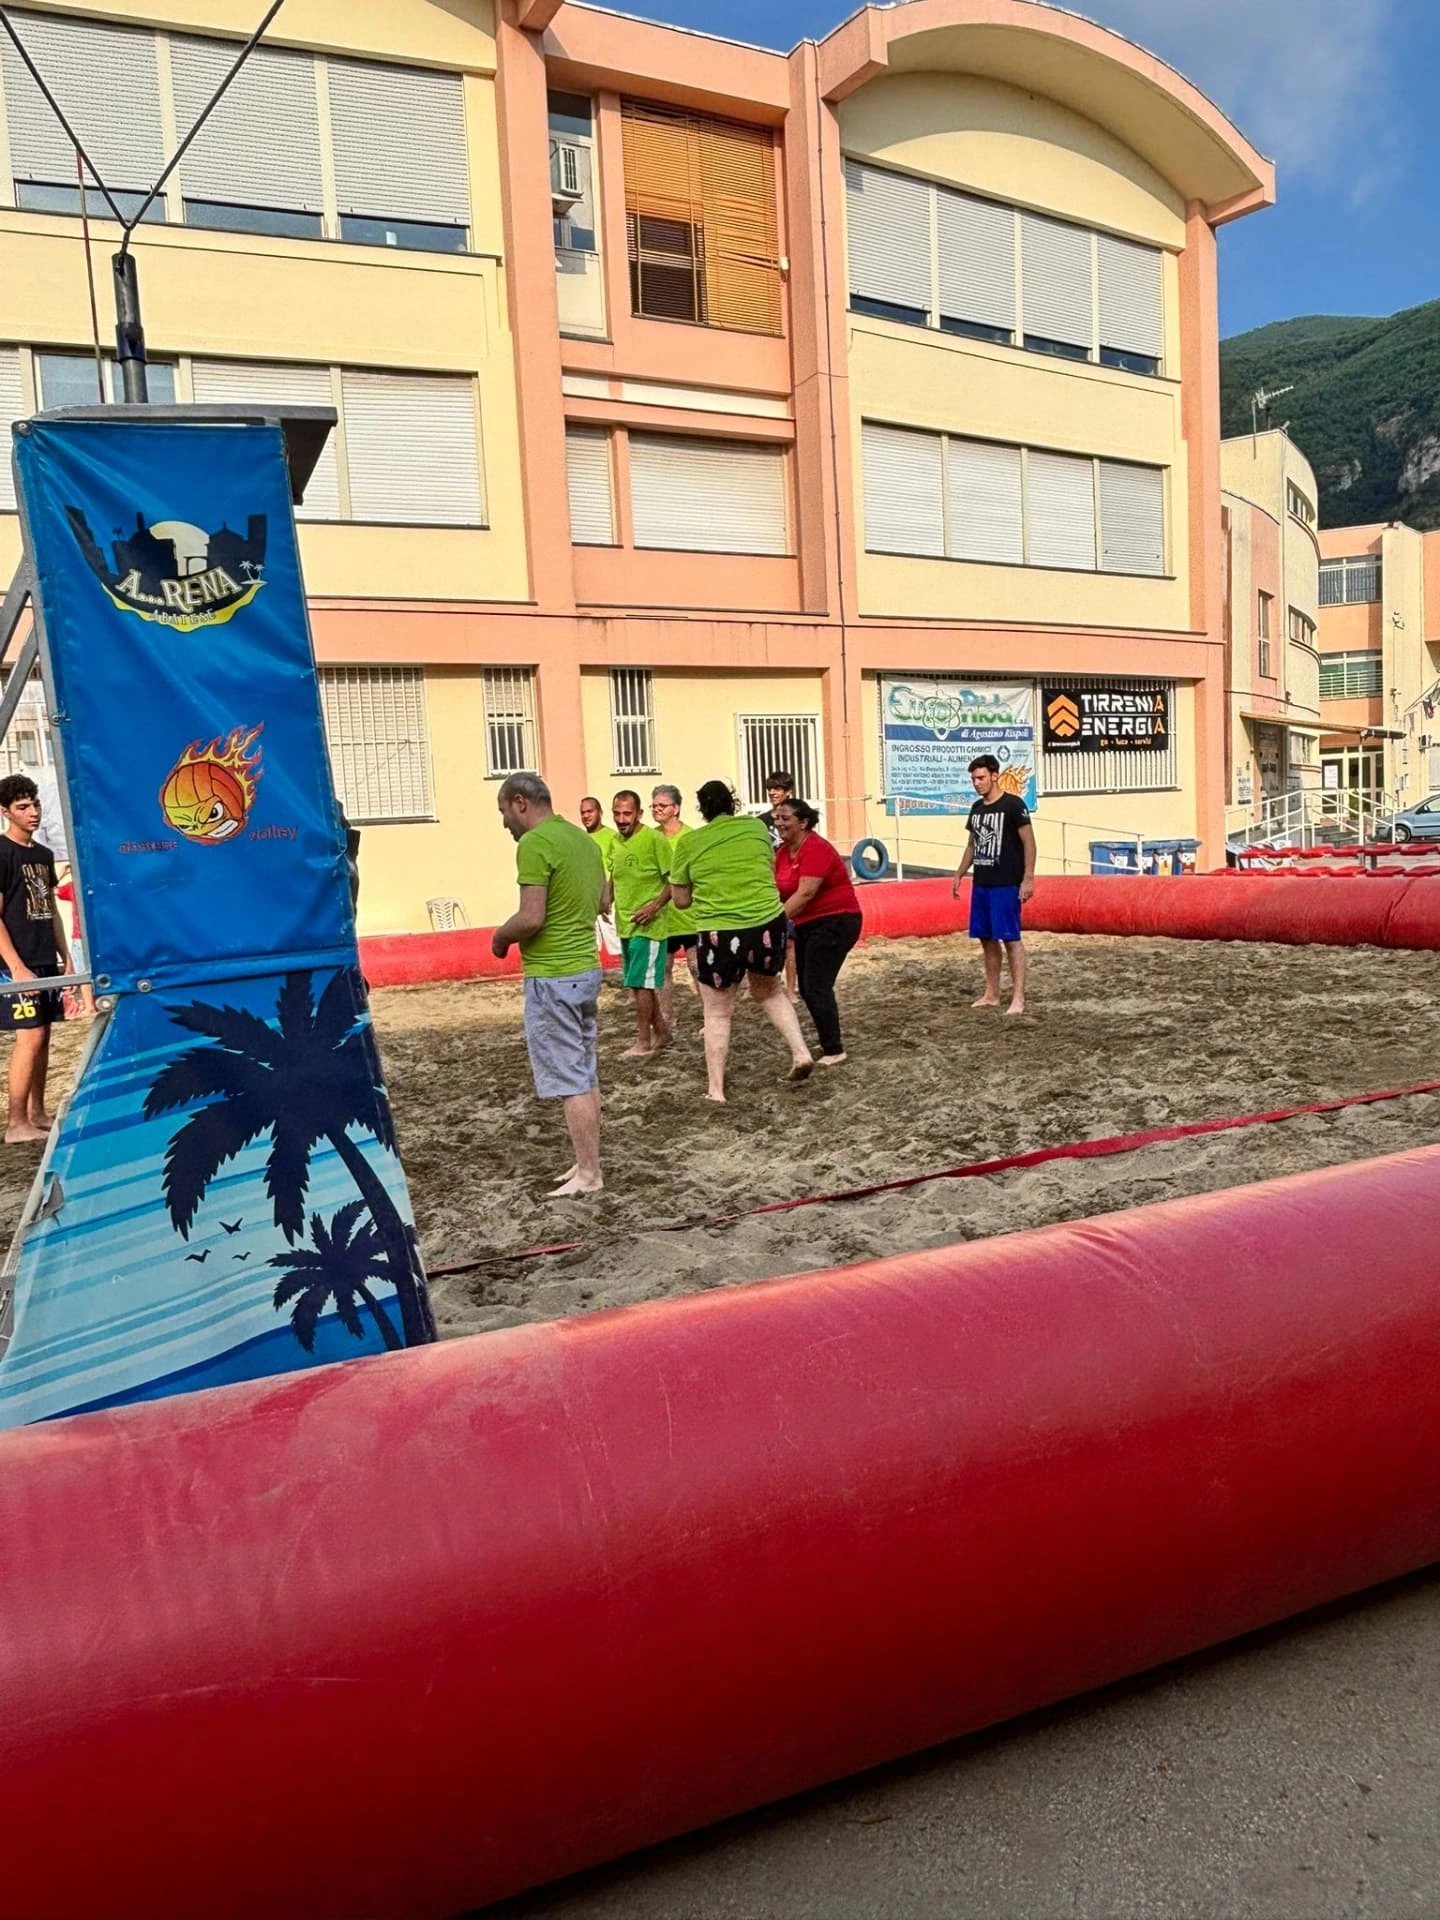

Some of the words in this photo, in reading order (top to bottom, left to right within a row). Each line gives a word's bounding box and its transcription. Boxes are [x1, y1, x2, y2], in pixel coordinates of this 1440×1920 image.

[1081, 694, 1165, 713] TIRRENIA
[969, 728, 1004, 740] Agostino
[1004, 728, 1030, 740] Rispoli
[1081, 717, 1166, 736] ENERGIA
[892, 744, 931, 753] INGROSSO
[931, 745, 966, 754] PRODOTTI
[897, 754, 943, 763] INDUSTRIALI
[12, 1002, 37, 1021] 26
